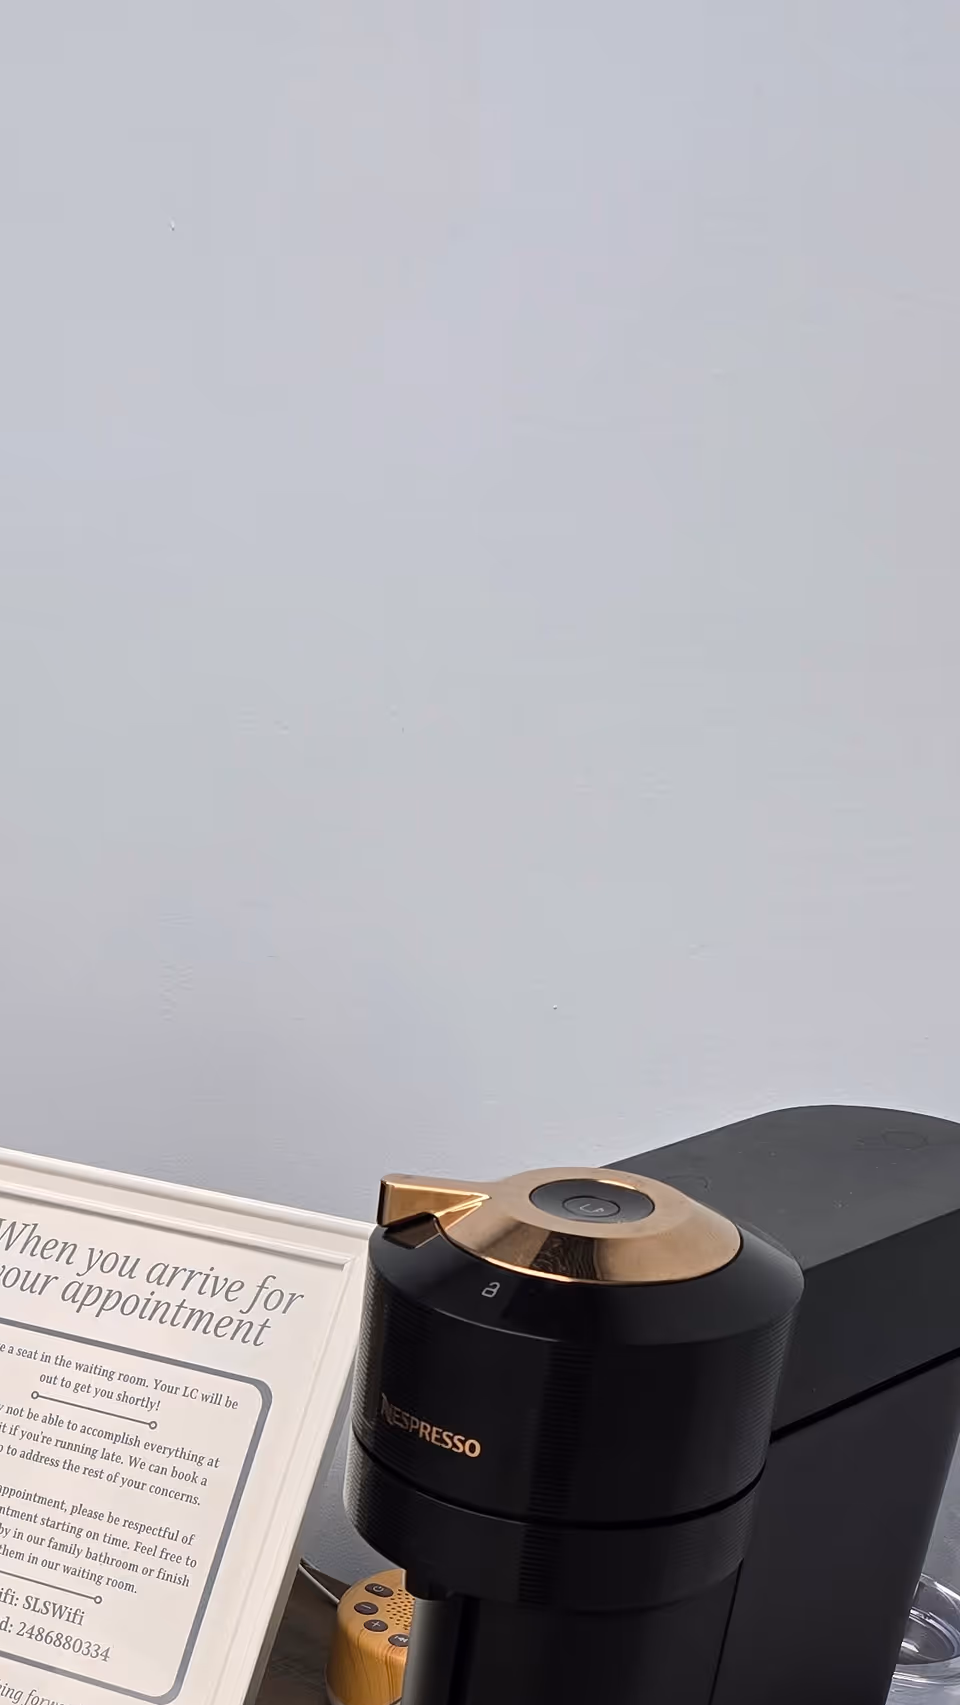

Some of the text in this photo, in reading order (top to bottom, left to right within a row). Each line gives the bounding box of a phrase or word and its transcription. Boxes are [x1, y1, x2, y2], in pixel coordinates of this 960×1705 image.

[60, 1280, 272, 1347] appointment
[75, 1247, 141, 1280] you
[145, 1262, 245, 1303] arrive
[238, 1274, 305, 1321] for
[7, 1345, 15, 1355] a
[15, 1347, 39, 1361] seat
[39, 1351, 52, 1364] in
[53, 1354, 73, 1369] the
[75, 1361, 117, 1382] waiting
[116, 1372, 149, 1388] room.
[153, 1378, 181, 1396] Your
[181, 1385, 200, 1400] LC
[200, 1392, 223, 1406] will
[224, 1395, 239, 1410] be
[39, 1373, 161, 1413] out to get you shortly!
[4, 1405, 25, 1418] not
[26, 1407, 40, 1422] be
[40, 1412, 65, 1428] able
[66, 1419, 79, 1432] to
[79, 1424, 141, 1449] accomplish
[143, 1441, 206, 1467] everything
[206, 1457, 221, 1469] at
[8, 1424, 21, 1437] if
[18, 1429, 53, 1446] you're
[53, 1438, 100, 1461] running
[99, 1447, 124, 1465] late.
[128, 1454, 147, 1470] We
[148, 1463, 168, 1476] can
[170, 1465, 199, 1484] book
[199, 1477, 208, 1487] a
[380, 1393, 481, 1458] NESPRESSO
[6, 1444, 18, 1457] to
[19, 1448, 61, 1468] address
[61, 1458, 81, 1474] the
[81, 1466, 105, 1480] rest
[105, 1471, 121, 1484] of
[118, 1476, 148, 1491] your
[148, 1484, 201, 1506] concerns.
[39, 1516, 84, 1539] starting
[85, 1529, 100, 1542] on
[102, 1532, 130, 1550] time.
[132, 1540, 158, 1558] Feel
[158, 1547, 183, 1565] free
[185, 1555, 197, 1569] to
[69, 1503, 105, 1522] please
[106, 1511, 121, 1526] be
[121, 1518, 180, 1542] respectful
[180, 1533, 196, 1546] of
[12, 1527, 24, 1541] in
[26, 1534, 47, 1547] our
[46, 1536, 84, 1559] family
[84, 1546, 139, 1573] bathroom
[141, 1566, 156, 1577] or
[155, 1567, 190, 1588] finish
[26, 1552, 39, 1566] in
[40, 1558, 61, 1572] our
[62, 1564, 105, 1587] waiting
[105, 1577, 137, 1594] room.
[22, 1595, 85, 1627] SLSWifi
[15, 1621, 111, 1663] 2486880334
